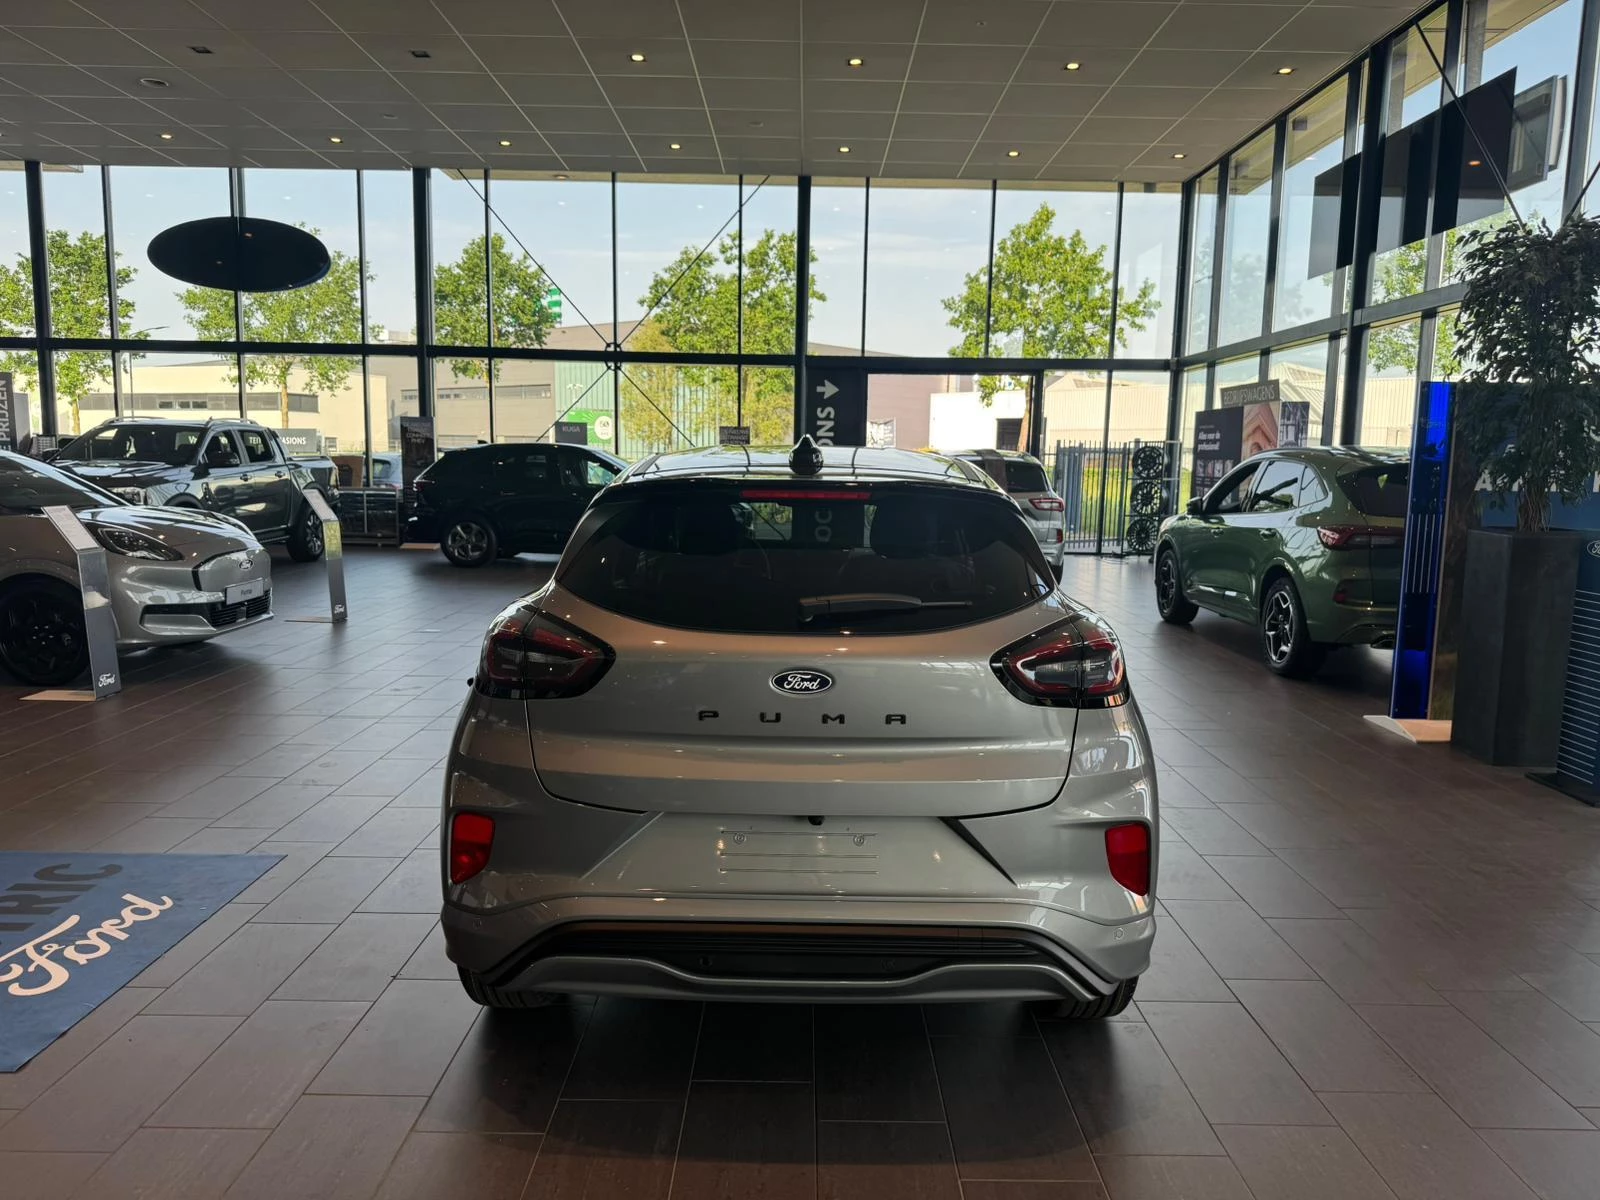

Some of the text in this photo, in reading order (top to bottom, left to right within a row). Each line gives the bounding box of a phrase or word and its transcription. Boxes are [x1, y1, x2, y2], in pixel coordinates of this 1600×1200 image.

[280, 436, 307, 445] ASIONS
[98, 672, 116, 688] Ford
[783, 673, 820, 690] Ford
[698, 710, 907, 725] PUMA
[0, 893, 174, 997] Ford
